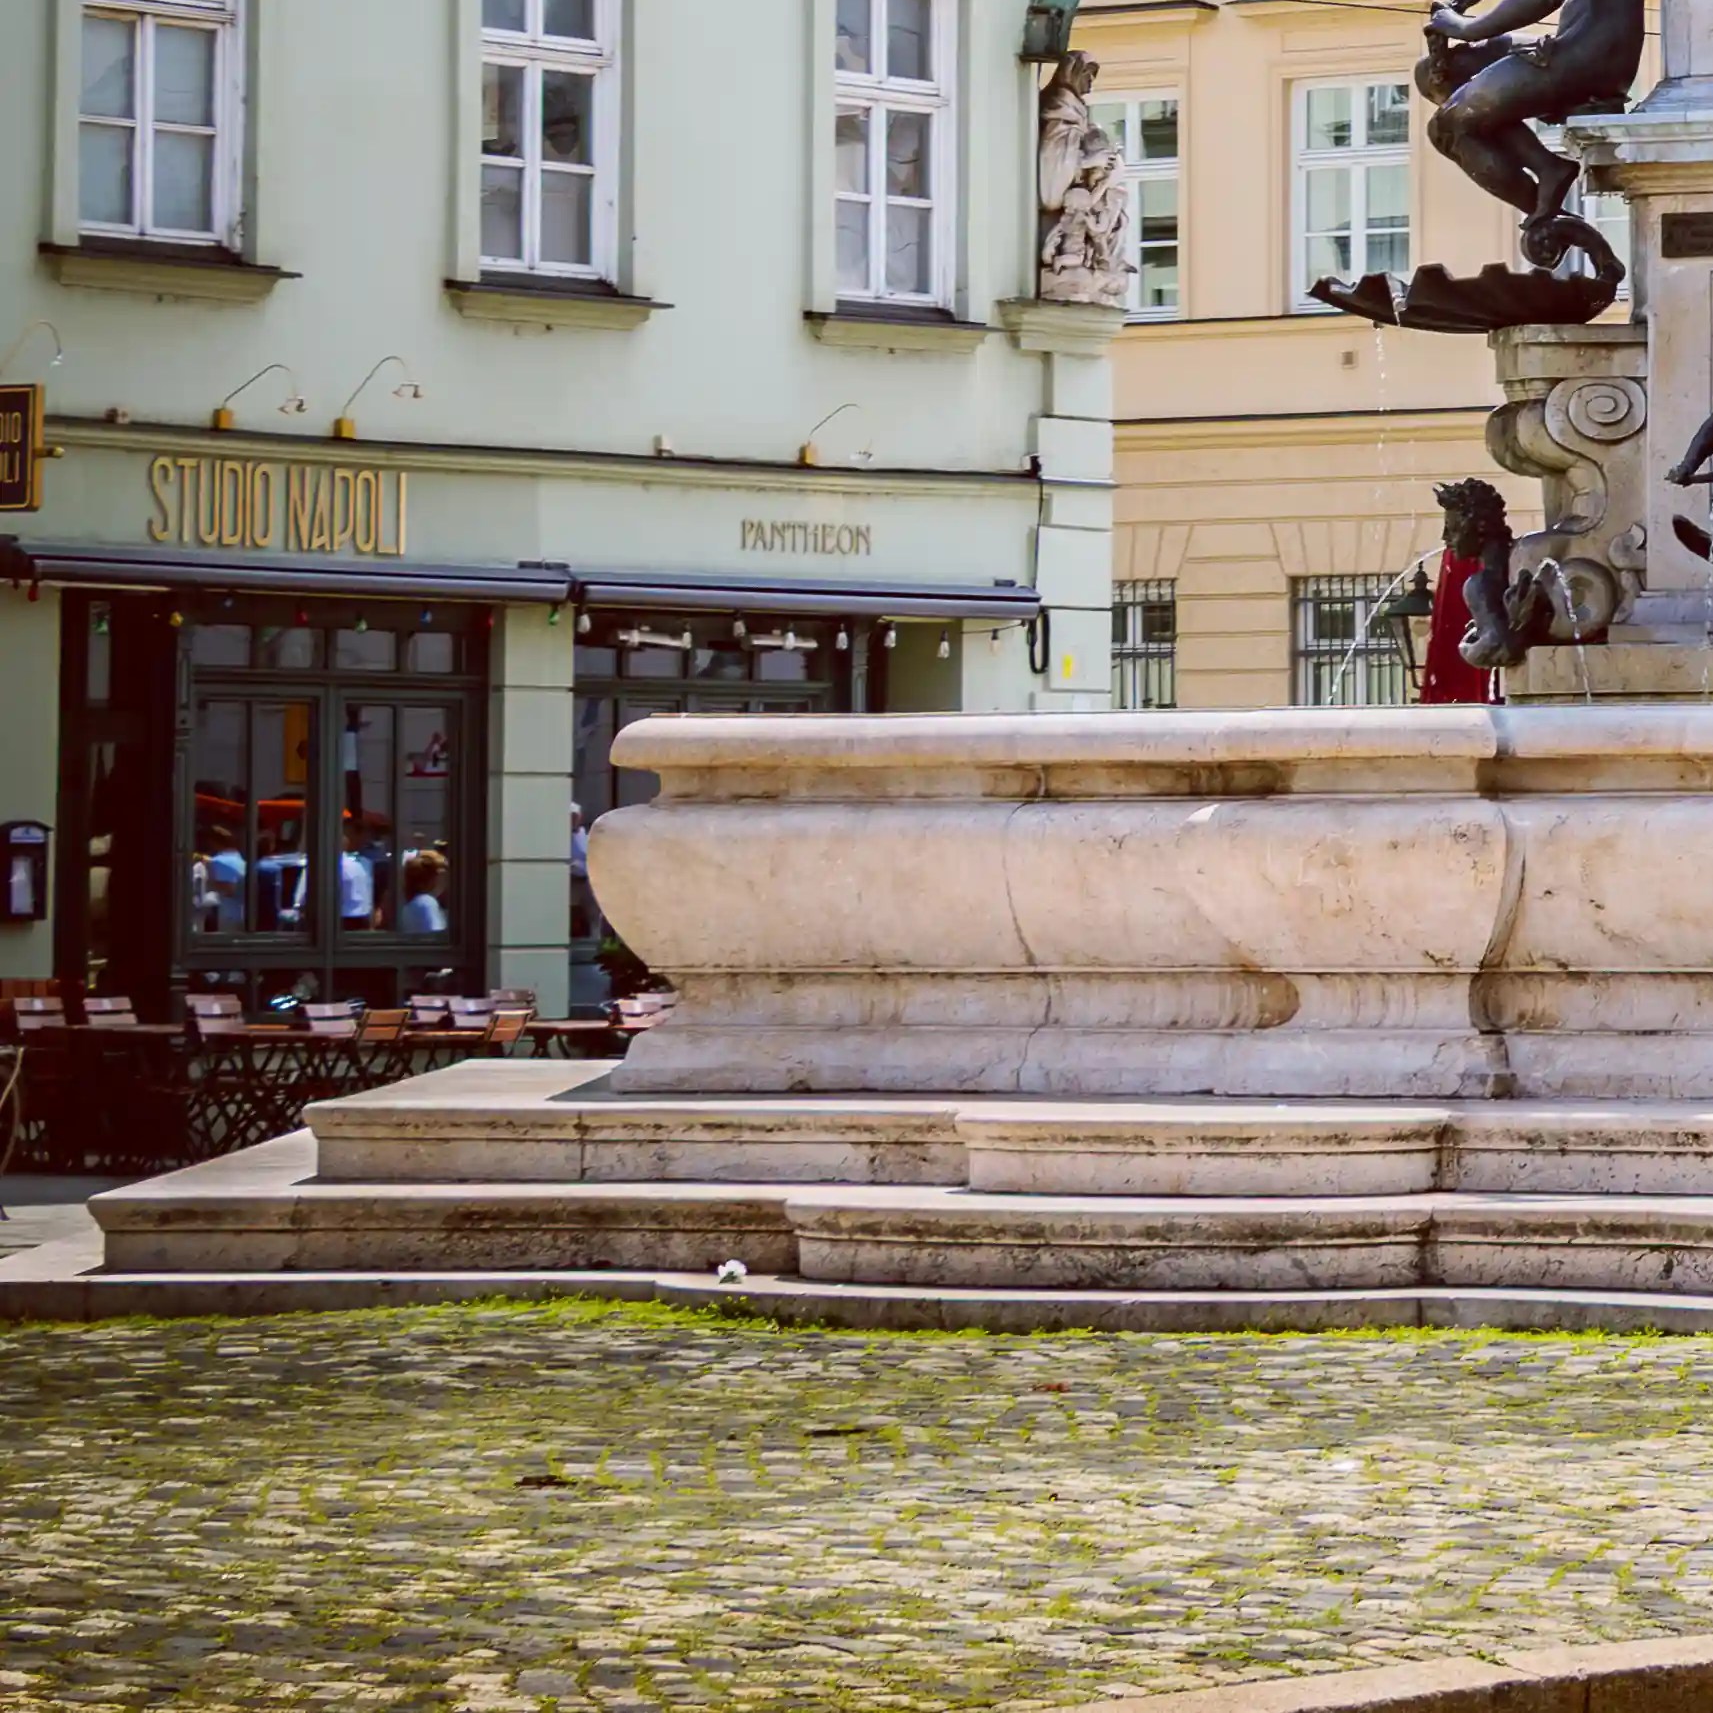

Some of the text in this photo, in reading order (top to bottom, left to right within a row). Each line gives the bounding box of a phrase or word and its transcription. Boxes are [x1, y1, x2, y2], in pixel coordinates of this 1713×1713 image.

[0, 450, 20, 483] LI
[149, 456, 407, 555] STUDIO NAPOLI
[740, 518, 872, 556] PANTHEON
